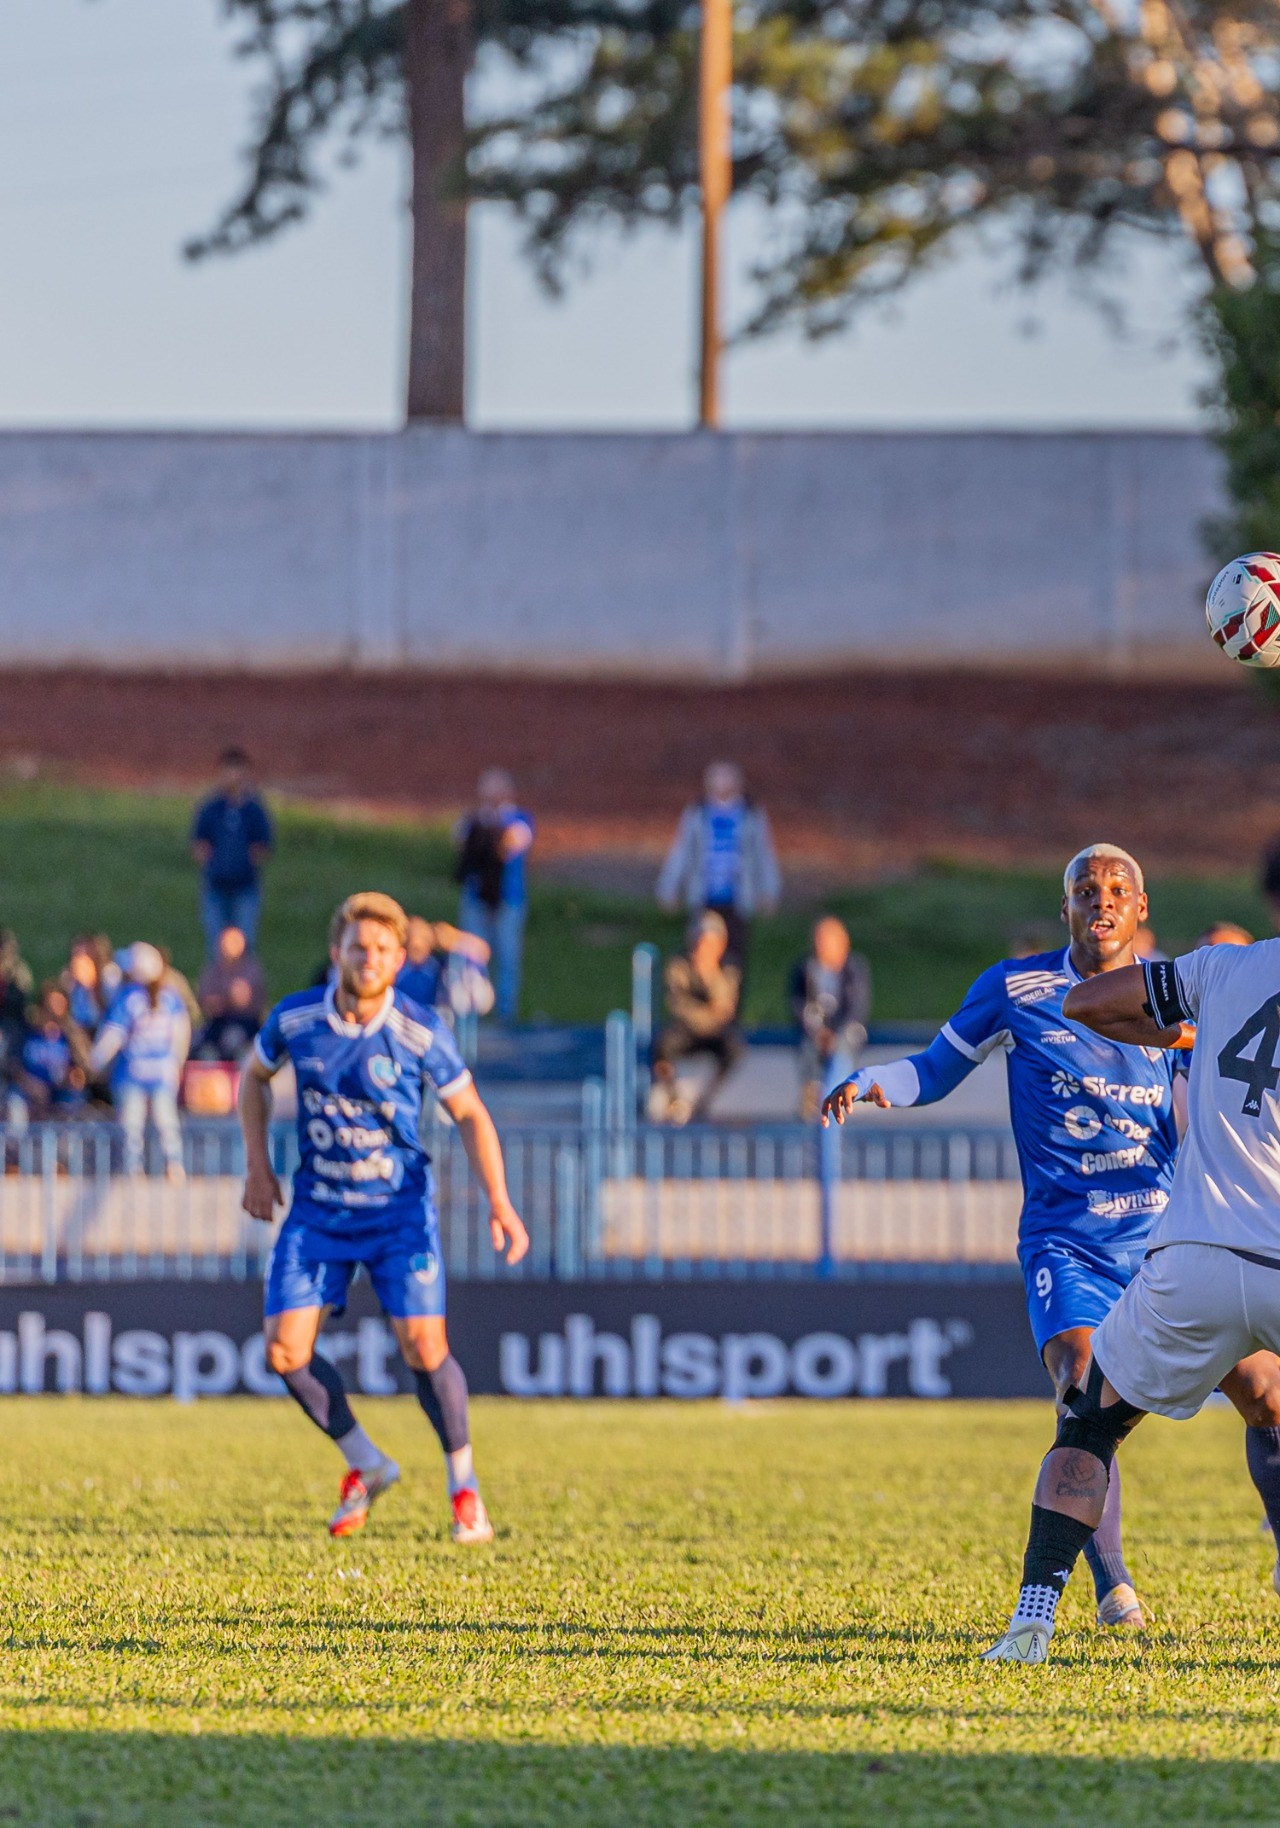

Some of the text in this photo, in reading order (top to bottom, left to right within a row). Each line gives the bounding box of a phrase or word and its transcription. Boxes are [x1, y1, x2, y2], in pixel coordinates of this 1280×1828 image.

[1081, 1076, 1165, 1108] Sicredi
[1036, 1267, 1053, 1297] 9
[501, 1313, 952, 1407] uhlsport
